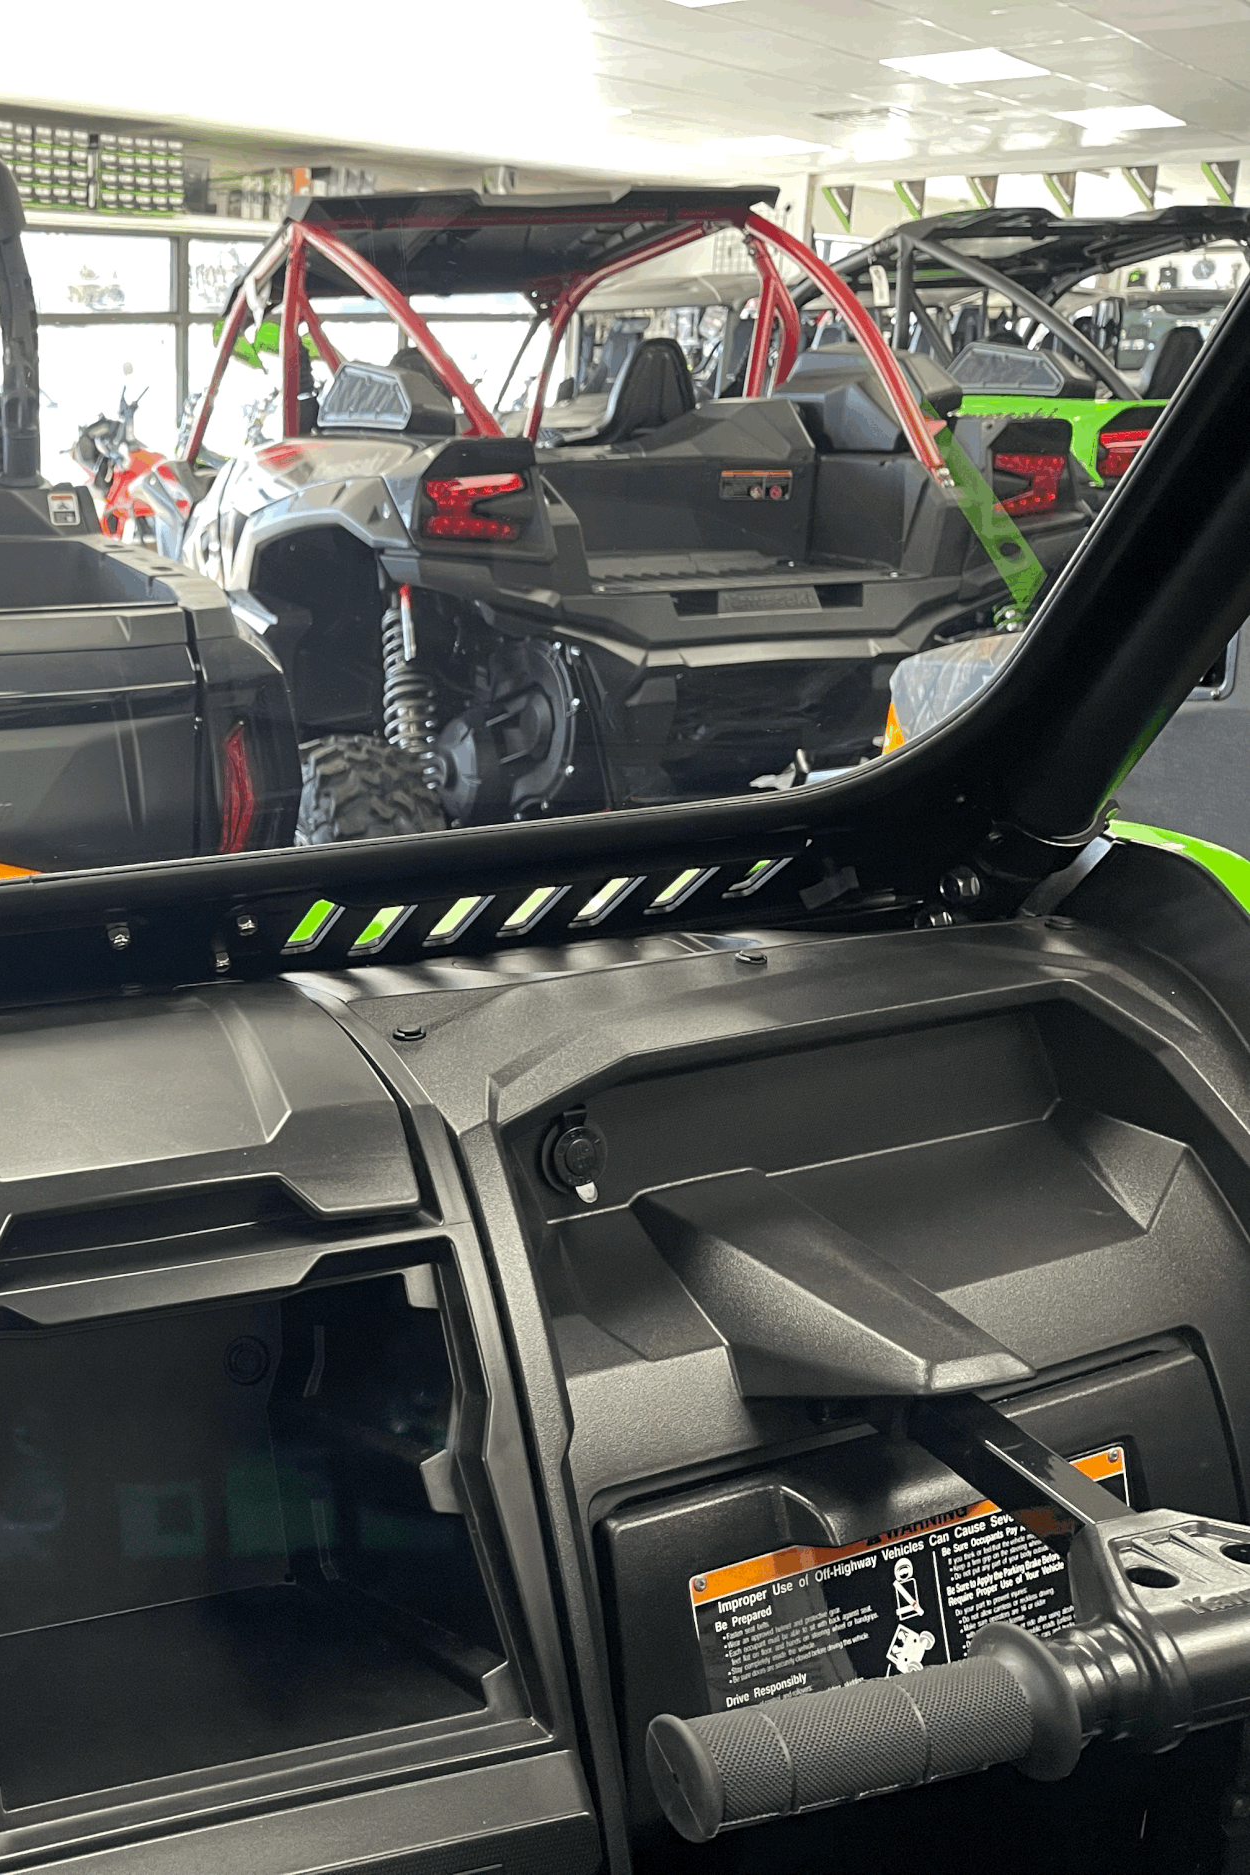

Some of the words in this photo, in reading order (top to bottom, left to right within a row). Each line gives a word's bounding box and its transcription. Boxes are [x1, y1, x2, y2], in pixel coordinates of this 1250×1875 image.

[941, 1546, 951, 1557] Be
[953, 1542, 968, 1553] Sure
[971, 1530, 1004, 1548] Occupants
[1005, 1526, 1018, 1537] Pay
[718, 1588, 768, 1614] Improper
[772, 1580, 794, 1597] Use
[799, 1573, 810, 1588] of
[815, 1554, 877, 1583] Off-Highway
[881, 1539, 925, 1562] Vehicles
[928, 1531, 950, 1548] Can
[954, 1520, 986, 1539] Cause
[954, 1572, 962, 1580] Do
[946, 1586, 956, 1597] Be
[955, 1582, 970, 1593] Sure
[976, 1573, 993, 1588] Apply
[993, 1570, 1004, 1581] the
[1003, 1564, 1025, 1578] Parking
[1025, 1557, 1042, 1570] Brake
[948, 1591, 974, 1607] Require
[976, 1583, 998, 1598] Proper
[1000, 1578, 1014, 1590] Use
[1015, 1573, 1023, 1584] of
[1025, 1569, 1040, 1581] Your
[1041, 1561, 1065, 1575] Vehicle
[715, 1620, 728, 1632] Be
[731, 1605, 773, 1627] Prepared
[962, 1615, 970, 1624] Do
[726, 1630, 743, 1640] Fasten
[728, 1648, 742, 1658] Each
[731, 1666, 743, 1675] Stay
[732, 1675, 740, 1684] Be
[726, 1692, 750, 1708] Drive
[753, 1672, 808, 1698] Responsibly
